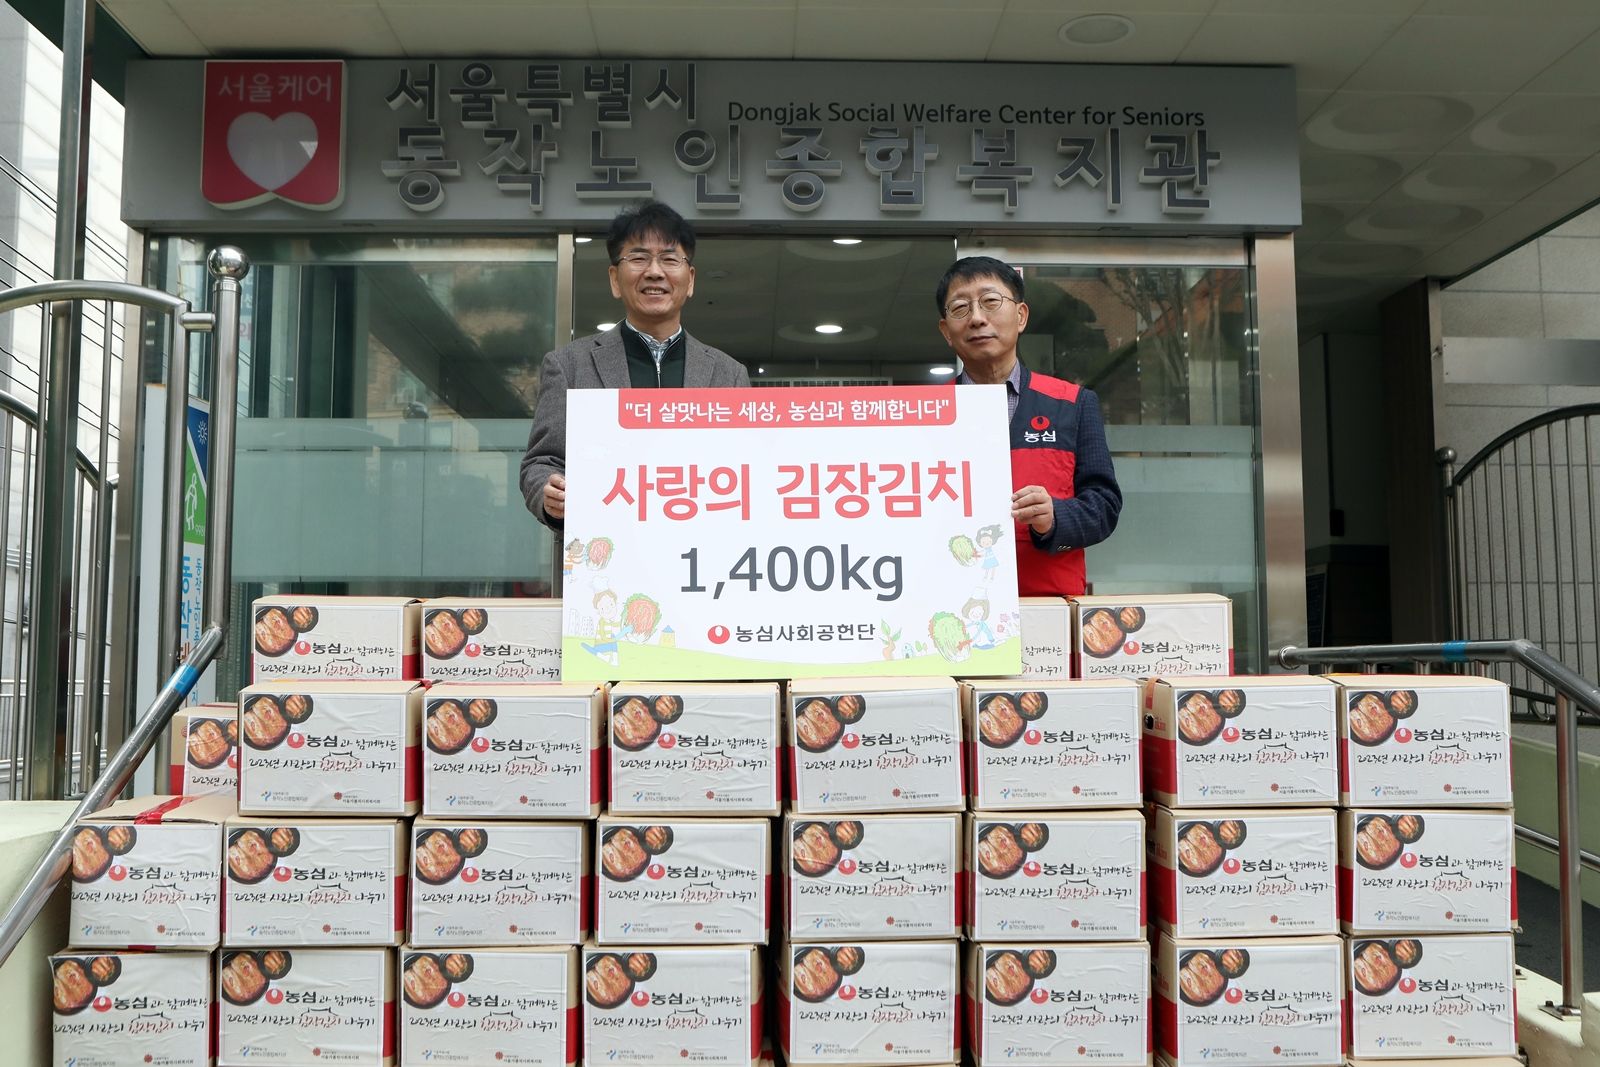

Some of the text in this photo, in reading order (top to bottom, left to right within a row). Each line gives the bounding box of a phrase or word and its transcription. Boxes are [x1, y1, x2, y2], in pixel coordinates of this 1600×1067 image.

[218, 73, 332, 103] 서울케어
[385, 62, 698, 128] 서울특별시
[728, 102, 1205, 126] Dongjak Social Welfare Center for Seniors
[380, 124, 1220, 214] 동작노인종합복지관
[625, 400, 950, 422] "더 살맛나는 세상, 농심과 함께합니다"
[1024, 430, 1056, 442] 농심
[602, 460, 973, 522] 사랑의 김장김치
[680, 543, 903, 602] 1,400kg
[736, 622, 876, 643] 농심사회공헌단
[260, 664, 394, 678] 2023년 사랑의 나누기
[430, 666, 492, 678] 2023년 사랑의
[1035, 666, 1062, 676] 나누기
[1090, 662, 1222, 674] 2023년 사랑의 나누기
[804, 754, 952, 770] 2023년 사랑의 나누기
[986, 754, 1130, 766] 2023년 사랑의 나누기
[1185, 750, 1328, 764] 2023년 사랑의 나누기
[1357, 752, 1502, 764] 2023년 사랑의 나누기
[248, 758, 280, 770] 2023년
[282, 760, 316, 770] 사랑의
[366, 760, 396, 772] 나누기
[432, 762, 582, 776] 2023년 사랑의 나누기
[620, 760, 768, 772] 2023년 사랑의 나누기
[800, 884, 946, 896] 2023년 사랑의 나누기
[1186, 882, 1328, 896] 2023년 사랑의 나누기
[1363, 878, 1502, 892] 2023년 사랑의 나누기
[71, 892, 137, 903] 2023년 사랑의
[234, 892, 386, 904] 2023년 사랑의 나누기
[422, 892, 572, 904] 2023년 사랑의 나누기
[608, 890, 756, 902] 2023년 사랑의 나누기
[984, 888, 1132, 900] 2023년 사랑의 나누기
[800, 1010, 946, 1022] 2023년 사랑의 나누기
[1362, 1002, 1506, 1016] 2023년 사랑의 나누기
[228, 1014, 374, 1030] 2023년 사랑의 나누기
[408, 1016, 558, 1032] 2023년 사랑의 나누기
[592, 1016, 742, 1030] 2023년 사랑의 나누기
[992, 1014, 1138, 1026] 2023년 사랑의 나누기
[1186, 1012, 1332, 1026] 2023년 사랑의 나누기
[54, 1023, 124, 1034] 2023년 사랑의
